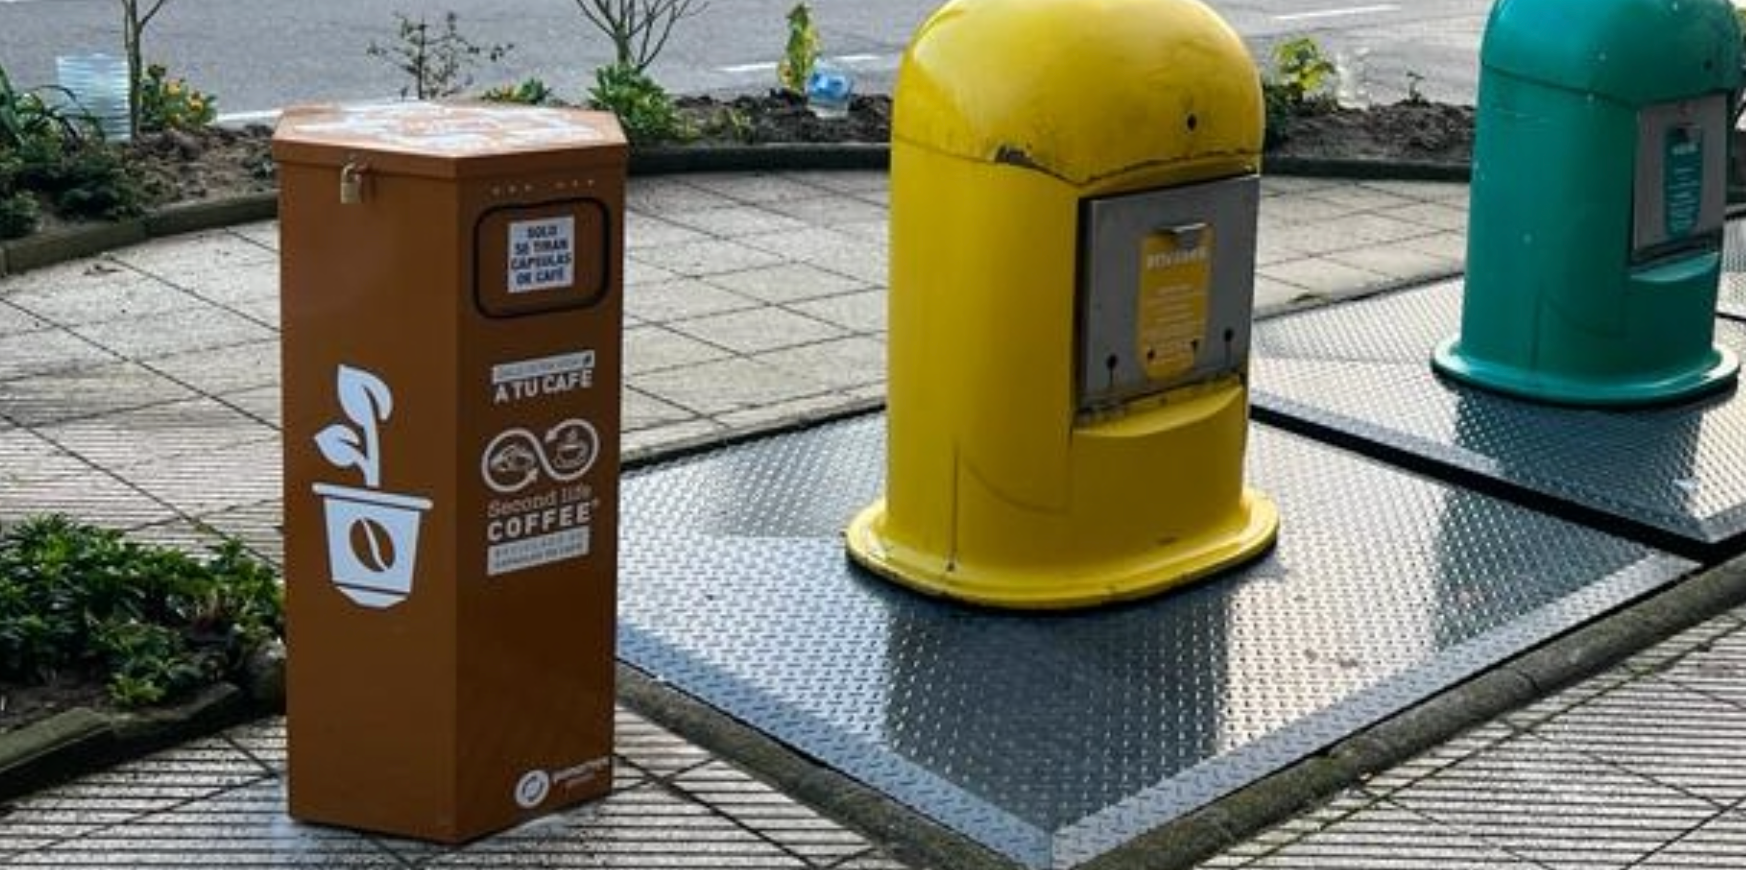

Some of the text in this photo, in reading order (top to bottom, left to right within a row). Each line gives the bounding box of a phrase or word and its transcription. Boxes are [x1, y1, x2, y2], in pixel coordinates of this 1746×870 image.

[528, 225, 557, 238] SOLO
[494, 384, 509, 403] A
[512, 378, 538, 400] TU
[487, 483, 592, 518] Second life
